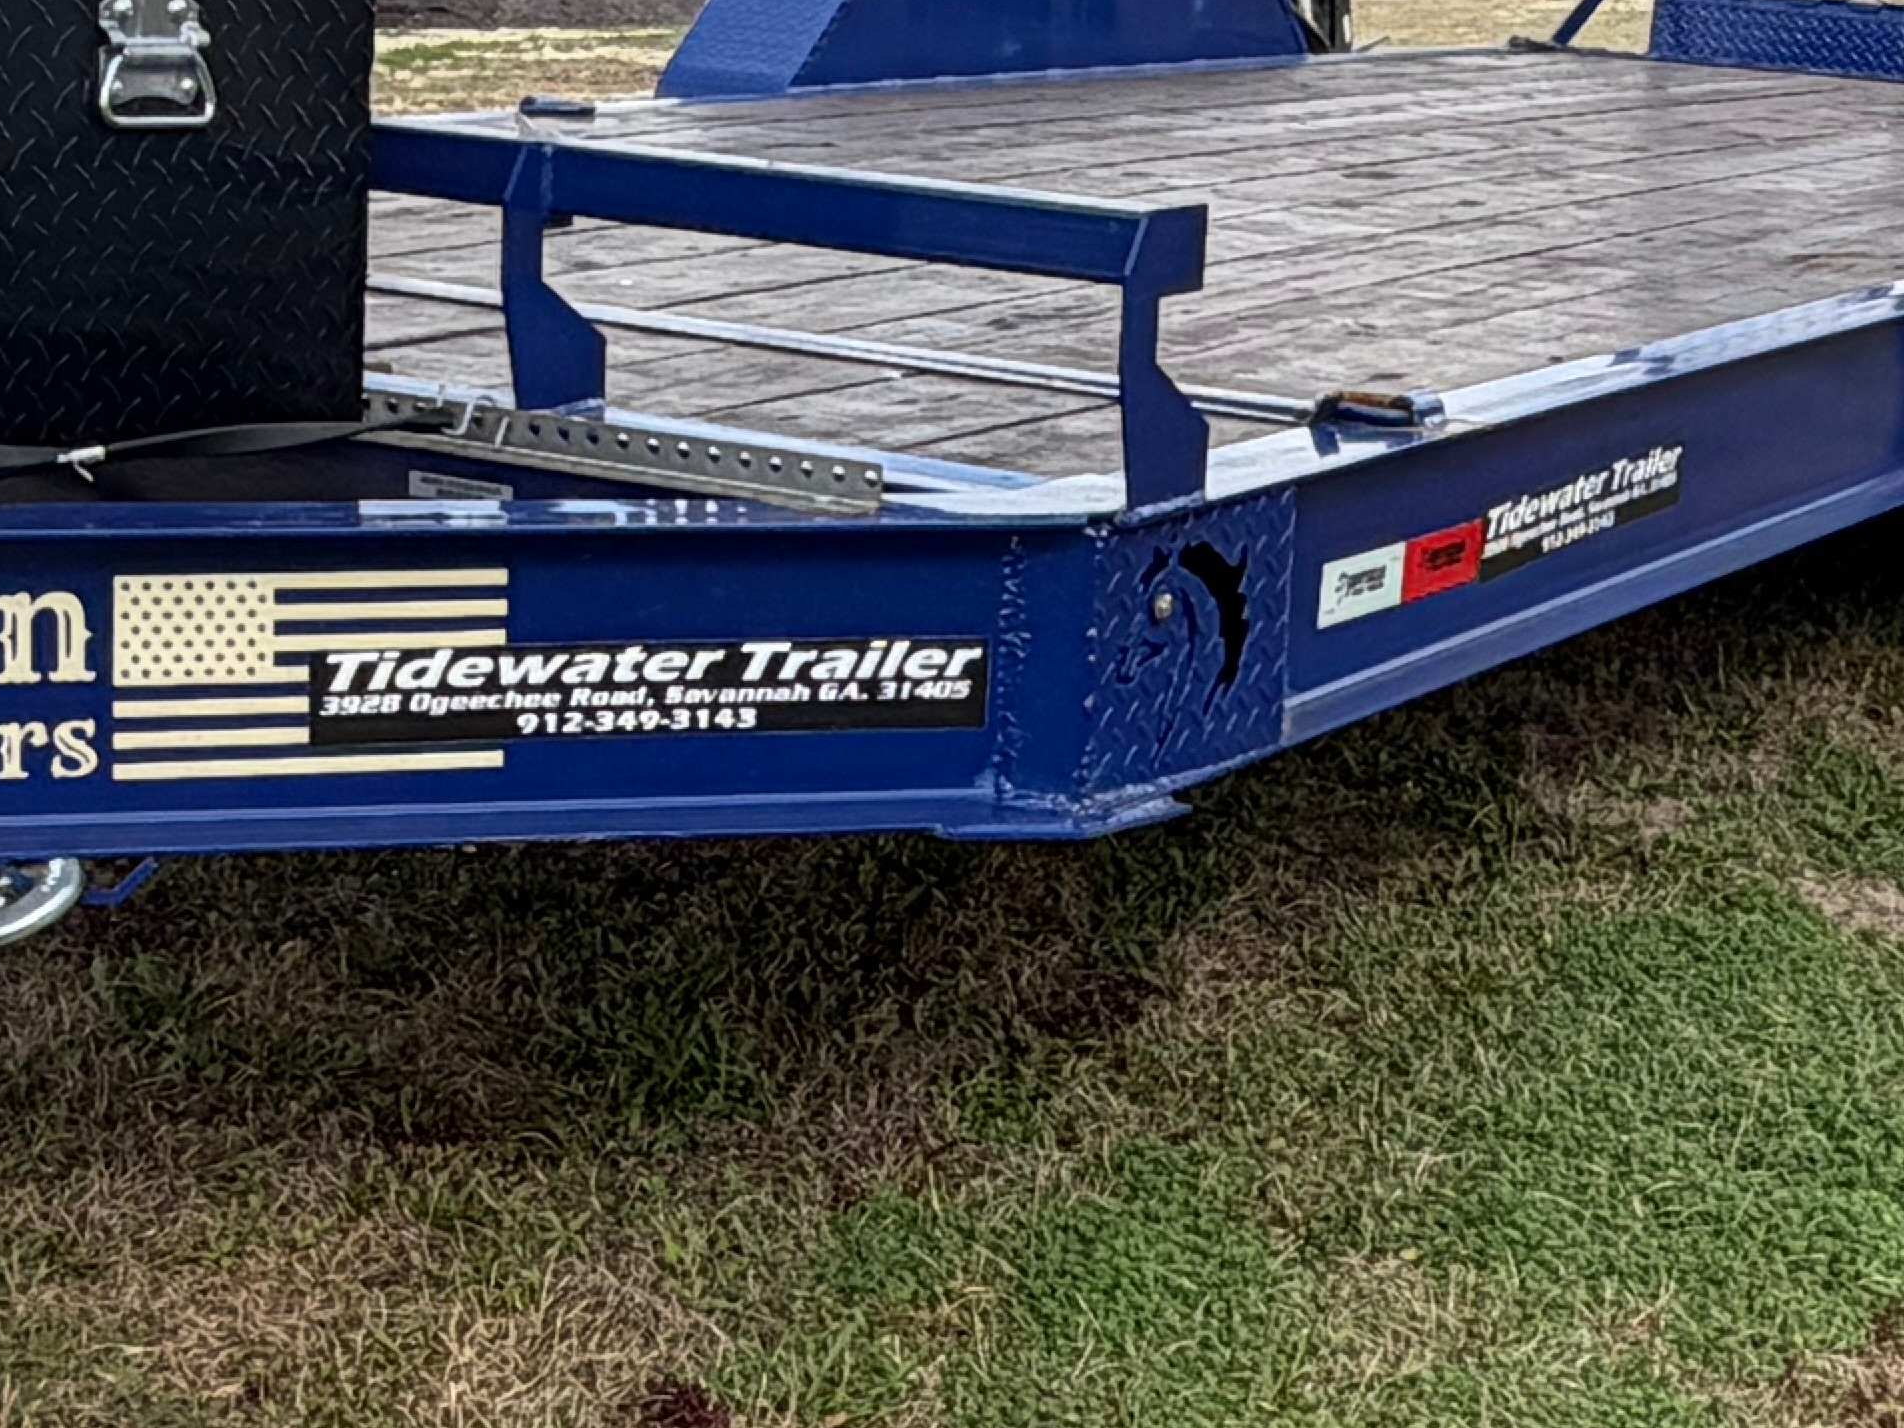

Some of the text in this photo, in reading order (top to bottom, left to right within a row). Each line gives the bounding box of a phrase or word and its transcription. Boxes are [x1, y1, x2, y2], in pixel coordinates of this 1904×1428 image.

[1485, 470, 1611, 540] Tidewater
[1610, 445, 1683, 491] Trailer
[325, 640, 983, 693] Tidewater Trailer
[318, 678, 973, 717] 3928 Ogeechee Road, Savannah GA. 31405
[516, 707, 758, 734] 912-349-3143
